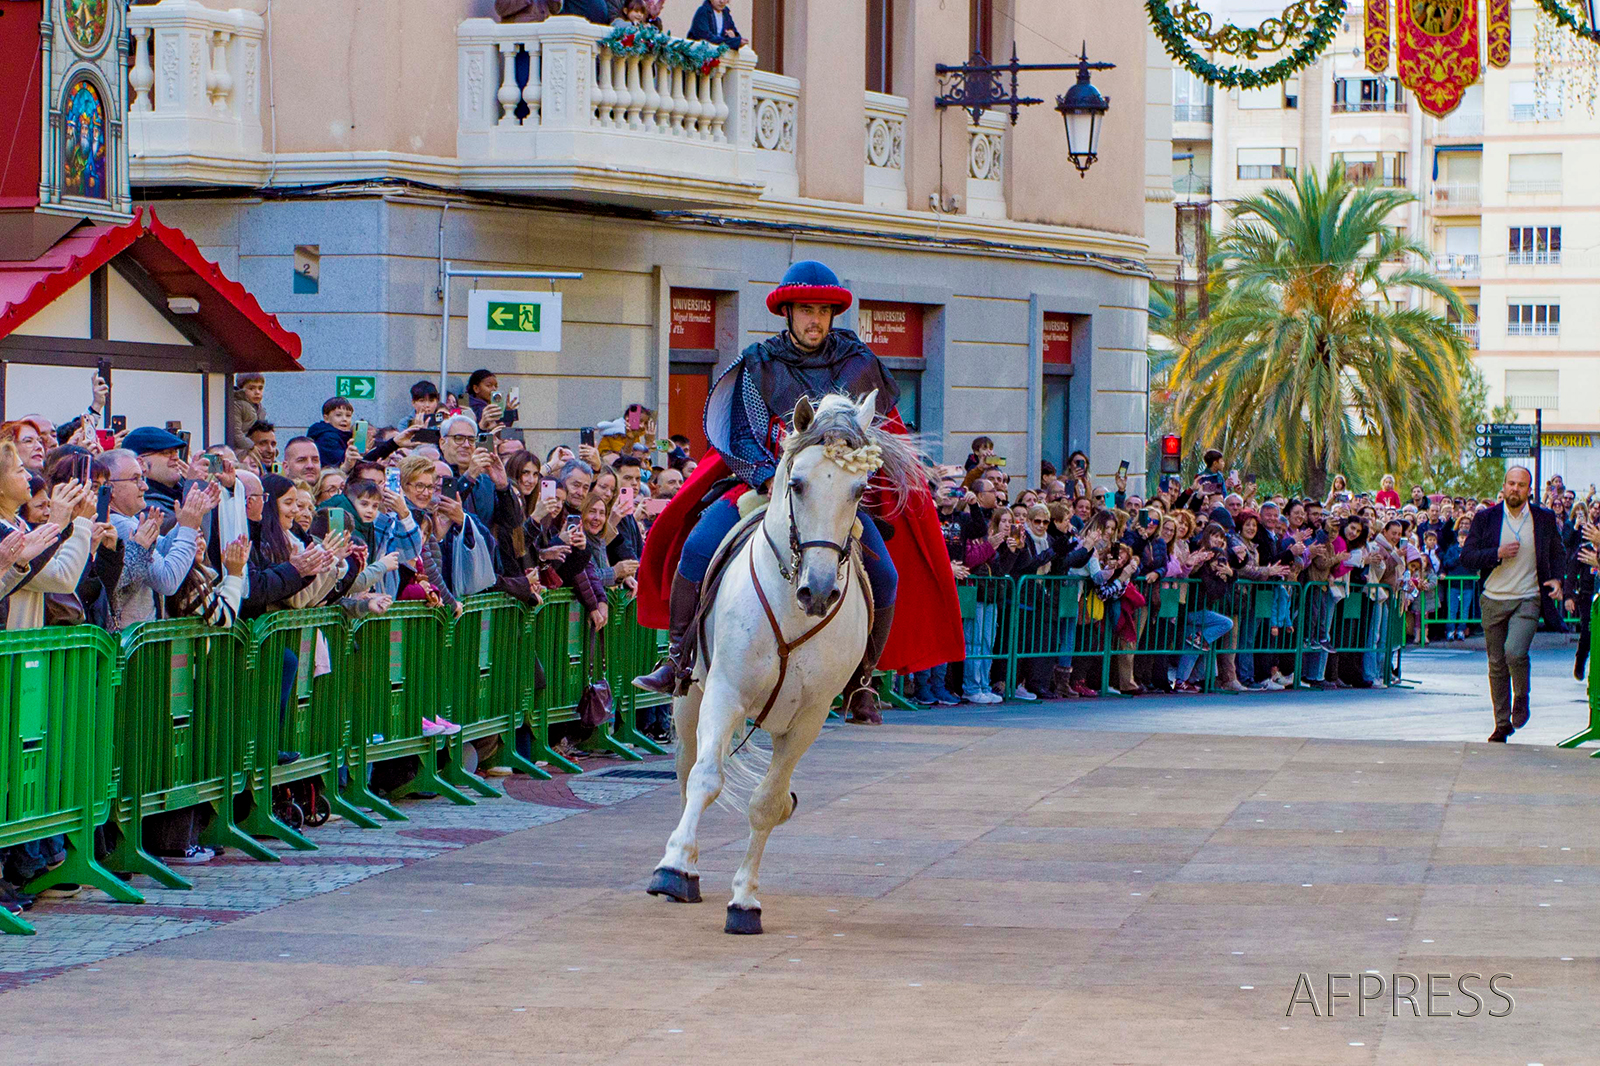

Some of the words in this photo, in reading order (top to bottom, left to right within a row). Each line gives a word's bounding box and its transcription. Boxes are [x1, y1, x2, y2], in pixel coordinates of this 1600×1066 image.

[303, 263, 310, 274] 2
[672, 299, 711, 311] UNIVERSITAS
[673, 312, 688, 324] Miguel
[873, 310, 906, 322] UNIVERSITAS
[1541, 434, 1592, 447] SESORIA
